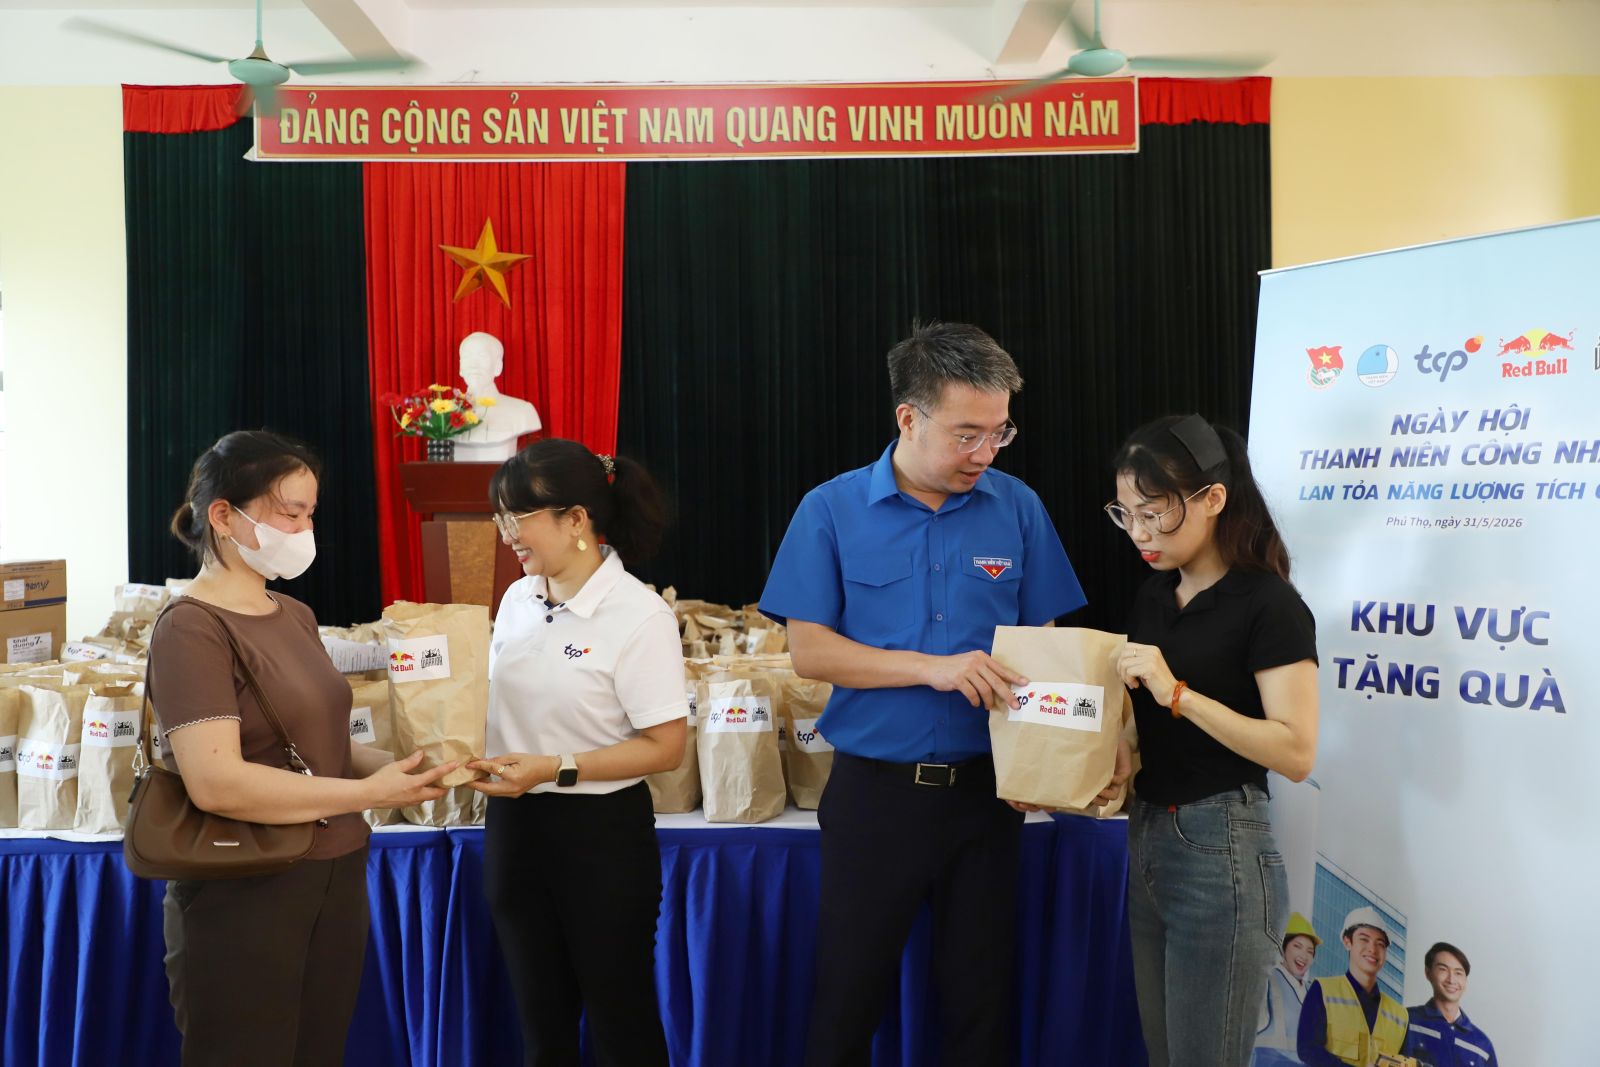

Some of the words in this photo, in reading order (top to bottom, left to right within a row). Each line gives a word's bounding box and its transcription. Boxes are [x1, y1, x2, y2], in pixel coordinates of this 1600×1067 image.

[279, 92, 368, 145] ĐẢNG
[381, 100, 470, 153] CỘNG
[482, 92, 549, 144] SẢN
[559, 100, 627, 153] VIỆT
[639, 107, 714, 143] NAM
[726, 104, 837, 147] QUANG
[847, 105, 923, 142] VINH
[935, 96, 1032, 141] MUÔN
[1044, 92, 1119, 137] NĂM
[1414, 344, 1469, 382] tcp
[1502, 362, 1532, 378] Red
[1535, 358, 1567, 376] Bull
[1390, 406, 1469, 435] NGÀY
[1477, 403, 1531, 436] HỘI
[1299, 447, 1382, 470] THANH
[1389, 441, 1451, 468] NIÊN
[1461, 438, 1542, 466] CÔNG
[1553, 439, 1600, 464] NH
[1299, 485, 1334, 501] LAN
[1342, 480, 1379, 500] TỎA
[1387, 480, 1443, 500] NĂNG
[1450, 481, 1524, 503] LƯỢNG
[1535, 479, 1586, 500] TÍCH
[1410, 516, 1432, 529] Thọ,
[1435, 516, 1461, 529] ngày
[1463, 517, 1523, 529] 31/5/2026
[1350, 600, 1435, 637] KHU
[1454, 606, 1550, 651] VỰC
[564, 643, 583, 660] tcp
[400, 664, 414, 672] Bull
[1333, 653, 1440, 700] TẶNG
[1459, 668, 1566, 714] QUÀ
[1040, 705, 1053, 715] Red
[1053, 707, 1066, 716] Bull
[796, 731, 815, 745] tcp
